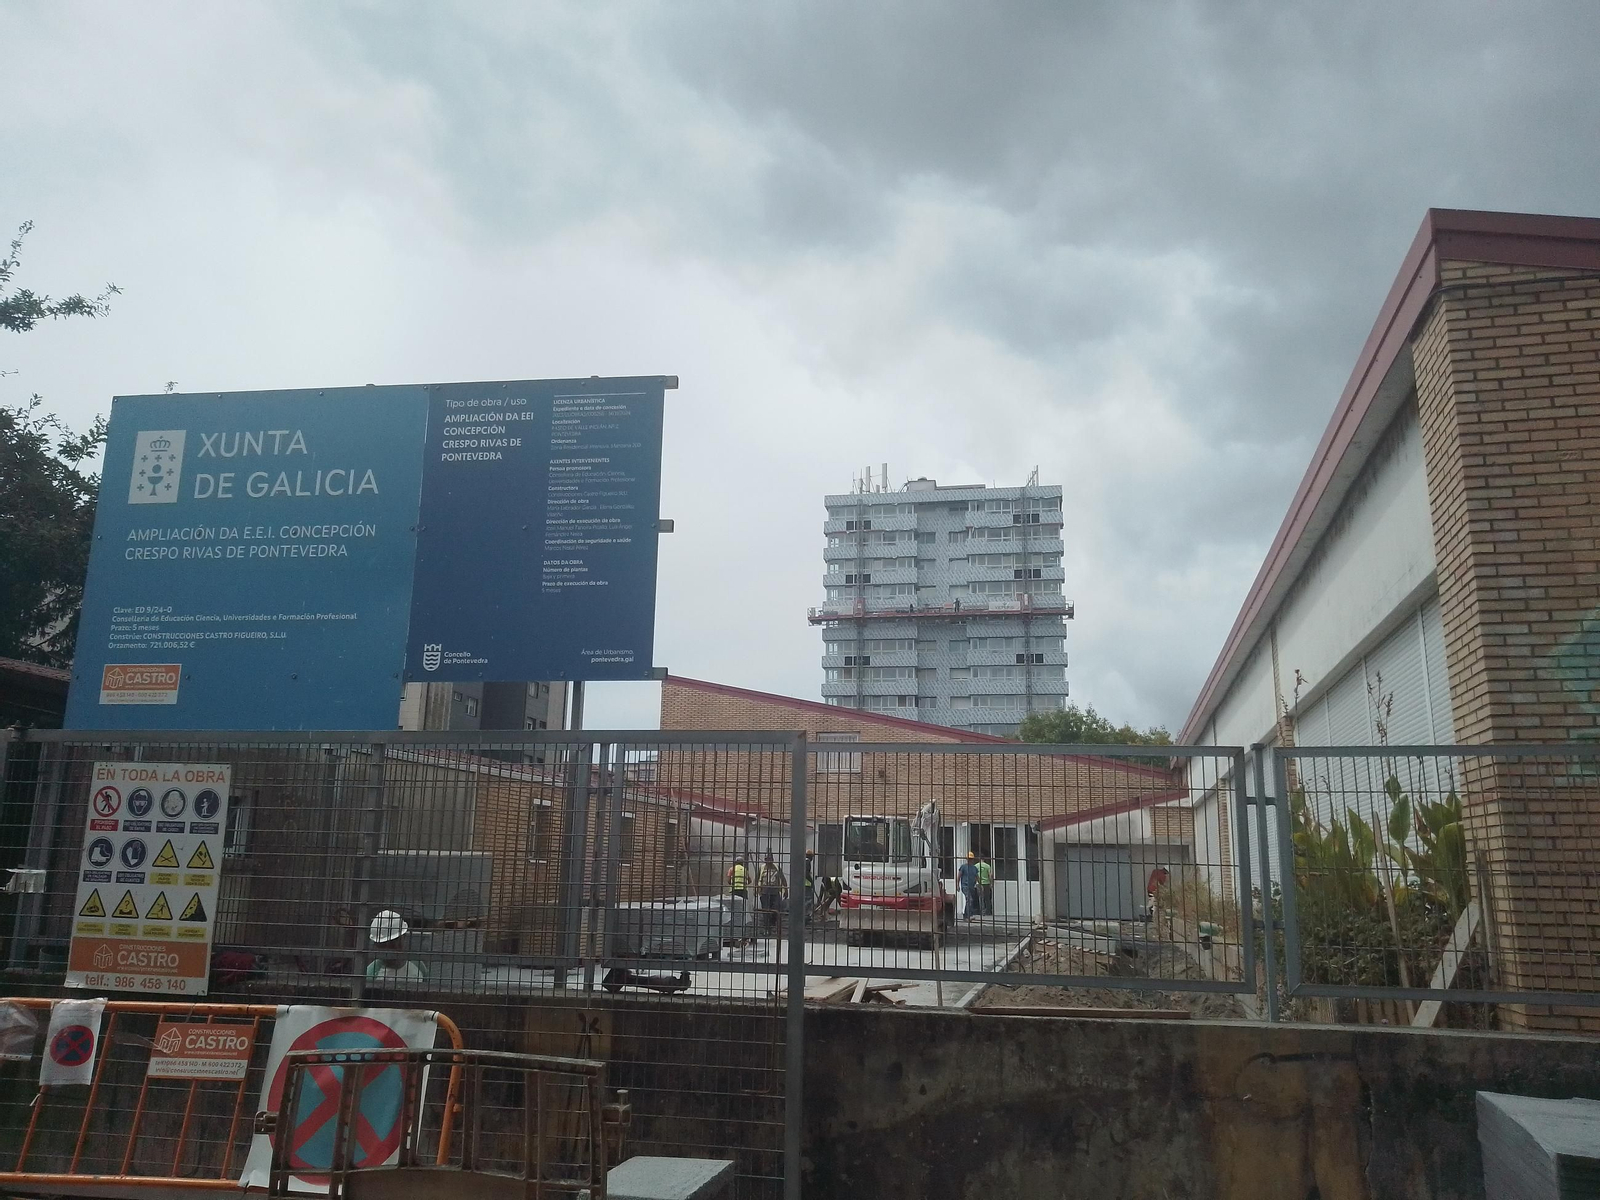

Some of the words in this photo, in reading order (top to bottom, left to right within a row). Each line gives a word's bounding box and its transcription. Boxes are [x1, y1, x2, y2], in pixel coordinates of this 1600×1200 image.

[445, 399, 465, 409] Tipo
[467, 399, 479, 407] de
[481, 398, 502, 407] obra
[511, 398, 527, 406] uso
[445, 412, 503, 423] AMPLIACIÓN
[505, 412, 519, 421] DA
[521, 412, 534, 421] EEI
[443, 424, 506, 436] CONCEPCIÓN
[197, 430, 308, 458] XUNTA
[442, 440, 478, 449] CRESPO
[480, 439, 508, 448] RIVAS
[510, 438, 522, 447] DE
[441, 451, 503, 462] PONTEVEDRA
[193, 472, 236, 499] DE
[246, 468, 379, 498] GALICIA
[127, 525, 215, 541] AMPLIACIÓN
[219, 527, 239, 540] DA
[243, 526, 275, 540] E.E.I.
[279, 521, 376, 539] CONCEPCIÓN
[125, 547, 179, 560] CRESPO
[182, 546, 222, 560] RIVAS
[226, 545, 245, 559] DE
[249, 544, 348, 558] PONTEVEDRA
[113, 606, 134, 614] Clave:
[135, 606, 145, 614] ED
[151, 614, 160, 622] de
[160, 614, 194, 622] Educación
[223, 613, 271, 621] Universidades
[278, 612, 315, 621] Formación
[316, 612, 358, 620] Profesional
[132, 623, 137, 631] 5
[143, 632, 204, 640] CONSTRUCCIONES
[205, 631, 233, 640] CASTRO
[125, 672, 176, 684] CASTRO
[97, 768, 116, 780] EN
[120, 768, 159, 782] TODA
[163, 770, 180, 783] LA
[184, 770, 226, 783] OBRA
[117, 950, 179, 967] CASTRO
[85, 974, 109, 987] telf.:
[114, 976, 135, 988] 986
[140, 977, 163, 990] 458
[166, 978, 186, 990] 140
[188, 1028, 237, 1036] CONSTRUCCIONES
[185, 1035, 249, 1051] CASTRO
